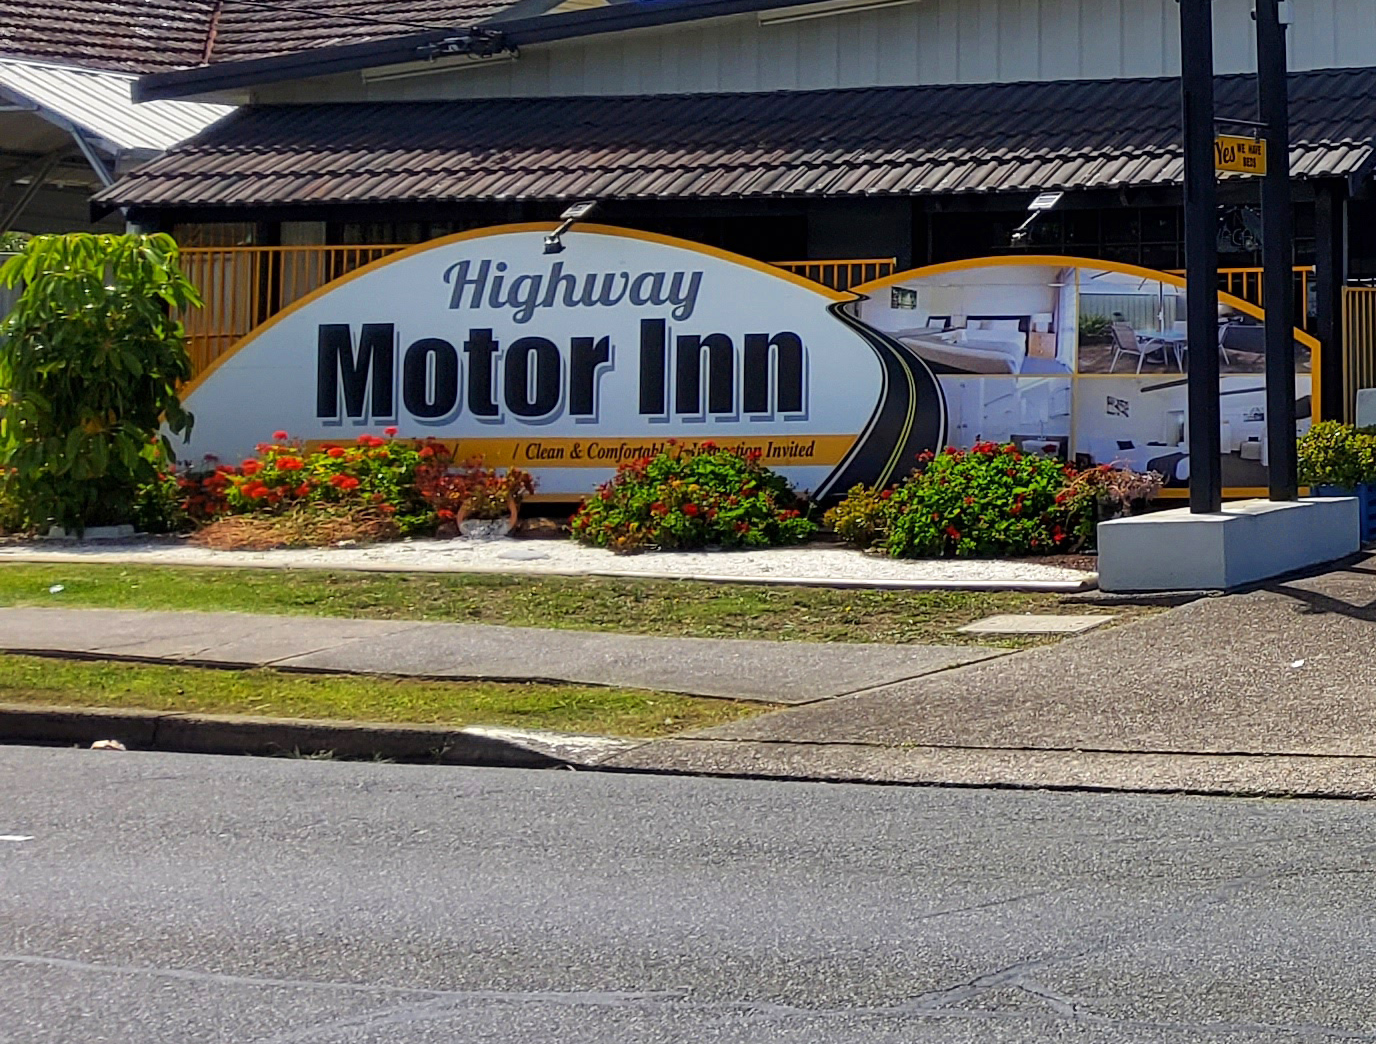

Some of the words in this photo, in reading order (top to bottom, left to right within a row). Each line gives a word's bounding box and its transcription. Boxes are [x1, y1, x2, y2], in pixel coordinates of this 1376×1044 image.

[1215, 141, 1236, 165] Yes
[442, 259, 703, 324] Highway
[315, 321, 613, 423] Motor
[638, 318, 807, 423] Inn
[525, 442, 565, 460] Clean
[569, 442, 582, 460] &
[586, 441, 668, 462] Comfortabl
[765, 440, 816, 458] Invited
